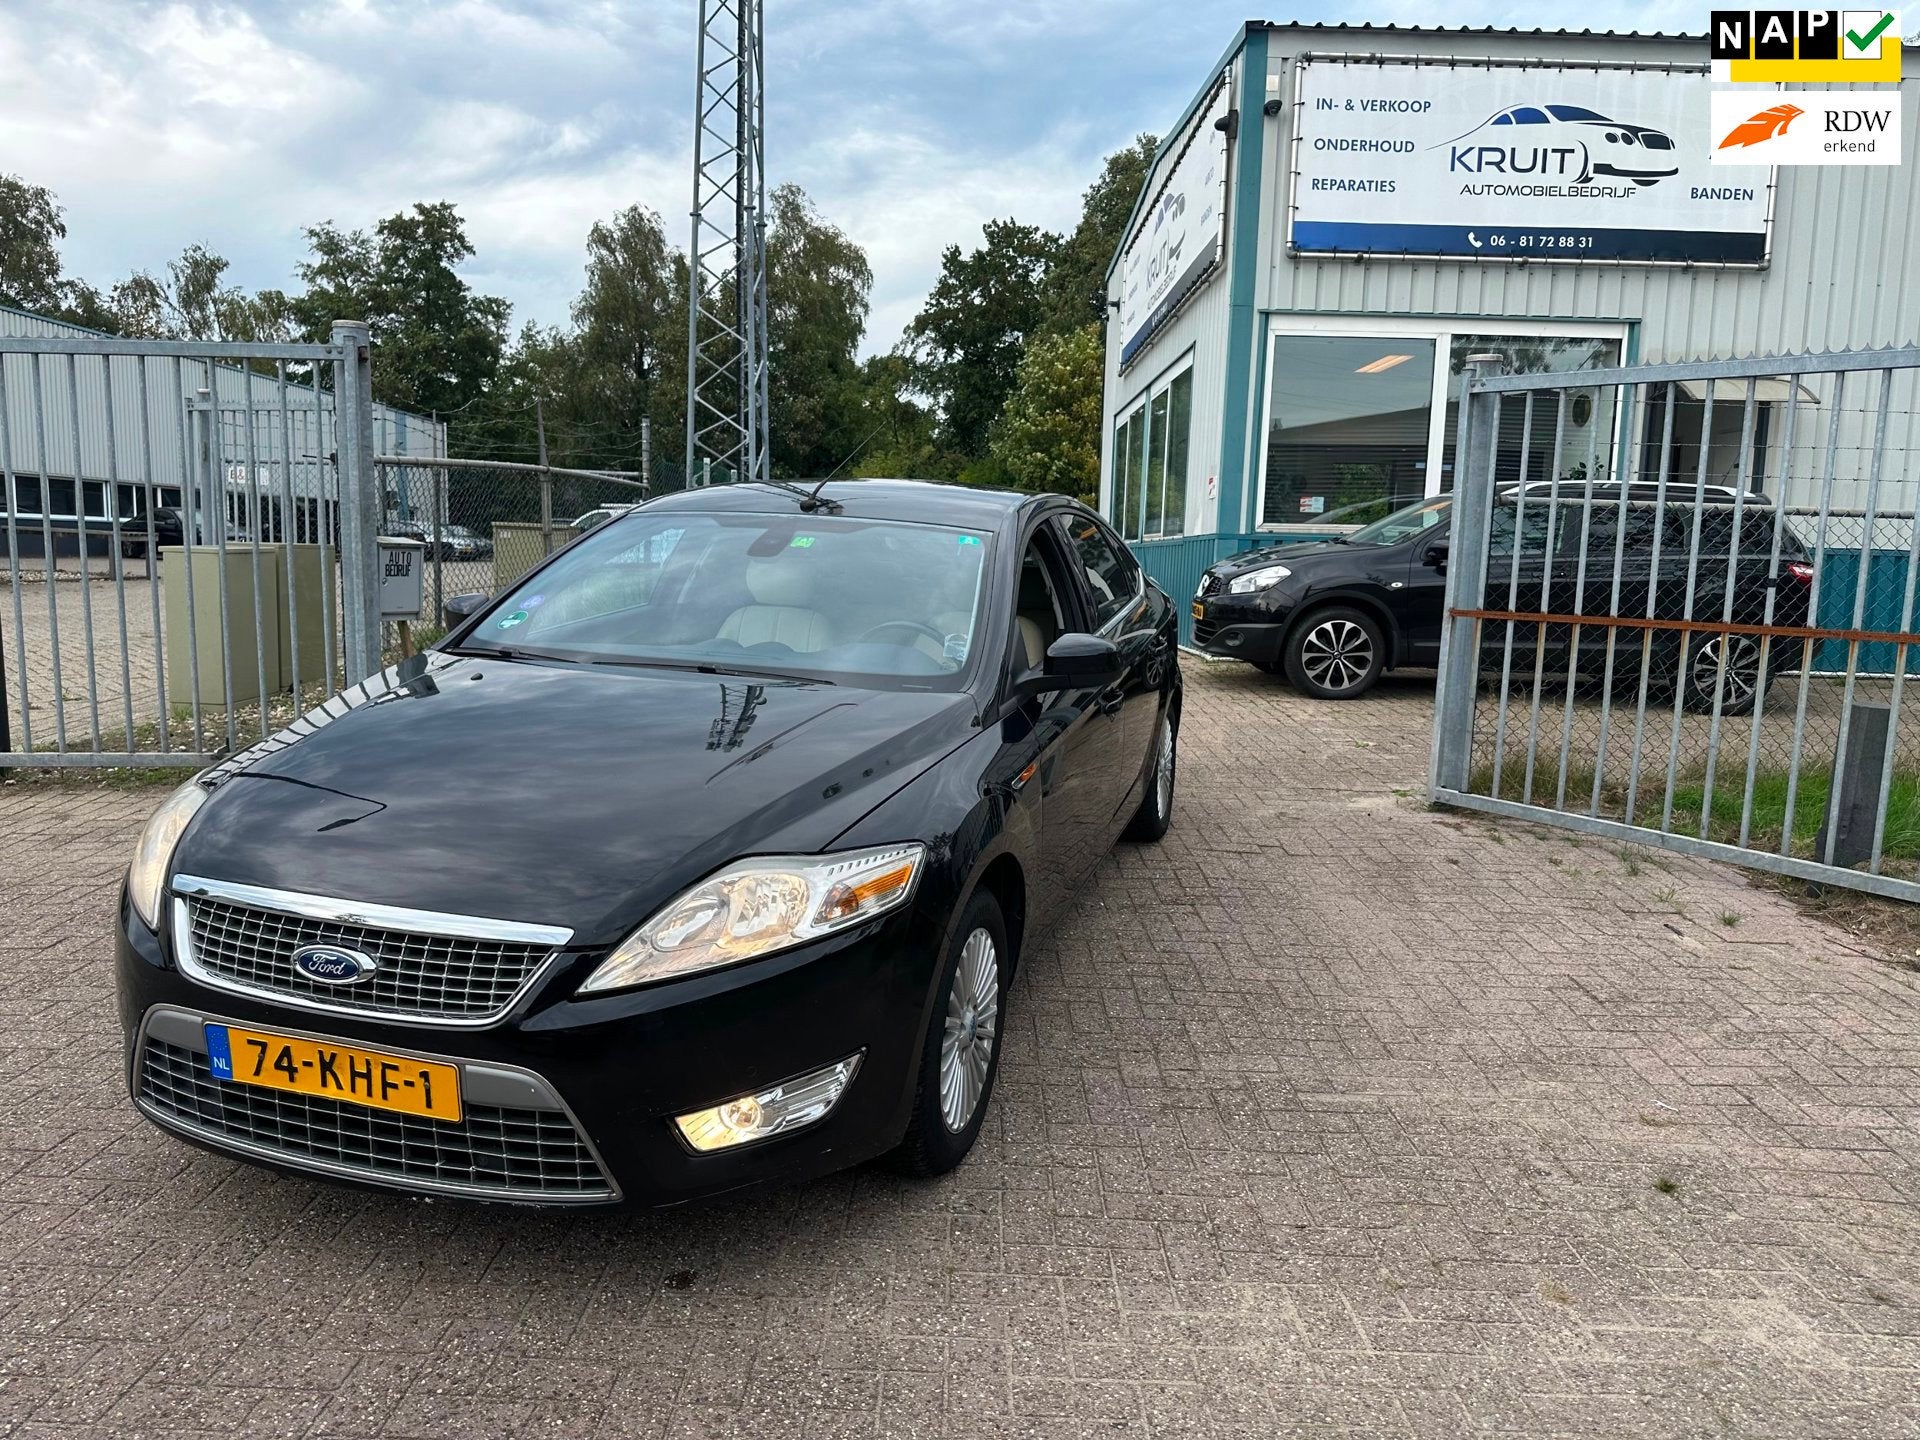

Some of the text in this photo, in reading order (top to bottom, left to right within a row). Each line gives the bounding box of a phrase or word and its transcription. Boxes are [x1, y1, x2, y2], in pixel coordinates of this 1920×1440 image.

[1316, 97, 1431, 113] IN- & VERKOOP
[1313, 138, 1415, 153] ONDERHOUD
[1449, 146, 1575, 175] KRUIT
[1311, 178, 1396, 193] REPARATIES
[1460, 184, 1637, 198] AUTOMOBIELBEDRIJF
[1690, 187, 1754, 201] BANDEN
[1490, 235, 1506, 246] 06
[1519, 236, 1534, 247] 81
[1539, 236, 1555, 248] 72
[1558, 236, 1575, 248] 88
[1578, 236, 1593, 248] 31
[388, 551, 412, 564] AUTO
[308, 953, 346, 976] Ford
[213, 1056, 230, 1071] NL
[246, 1038, 433, 1110] 74-KHF-1
